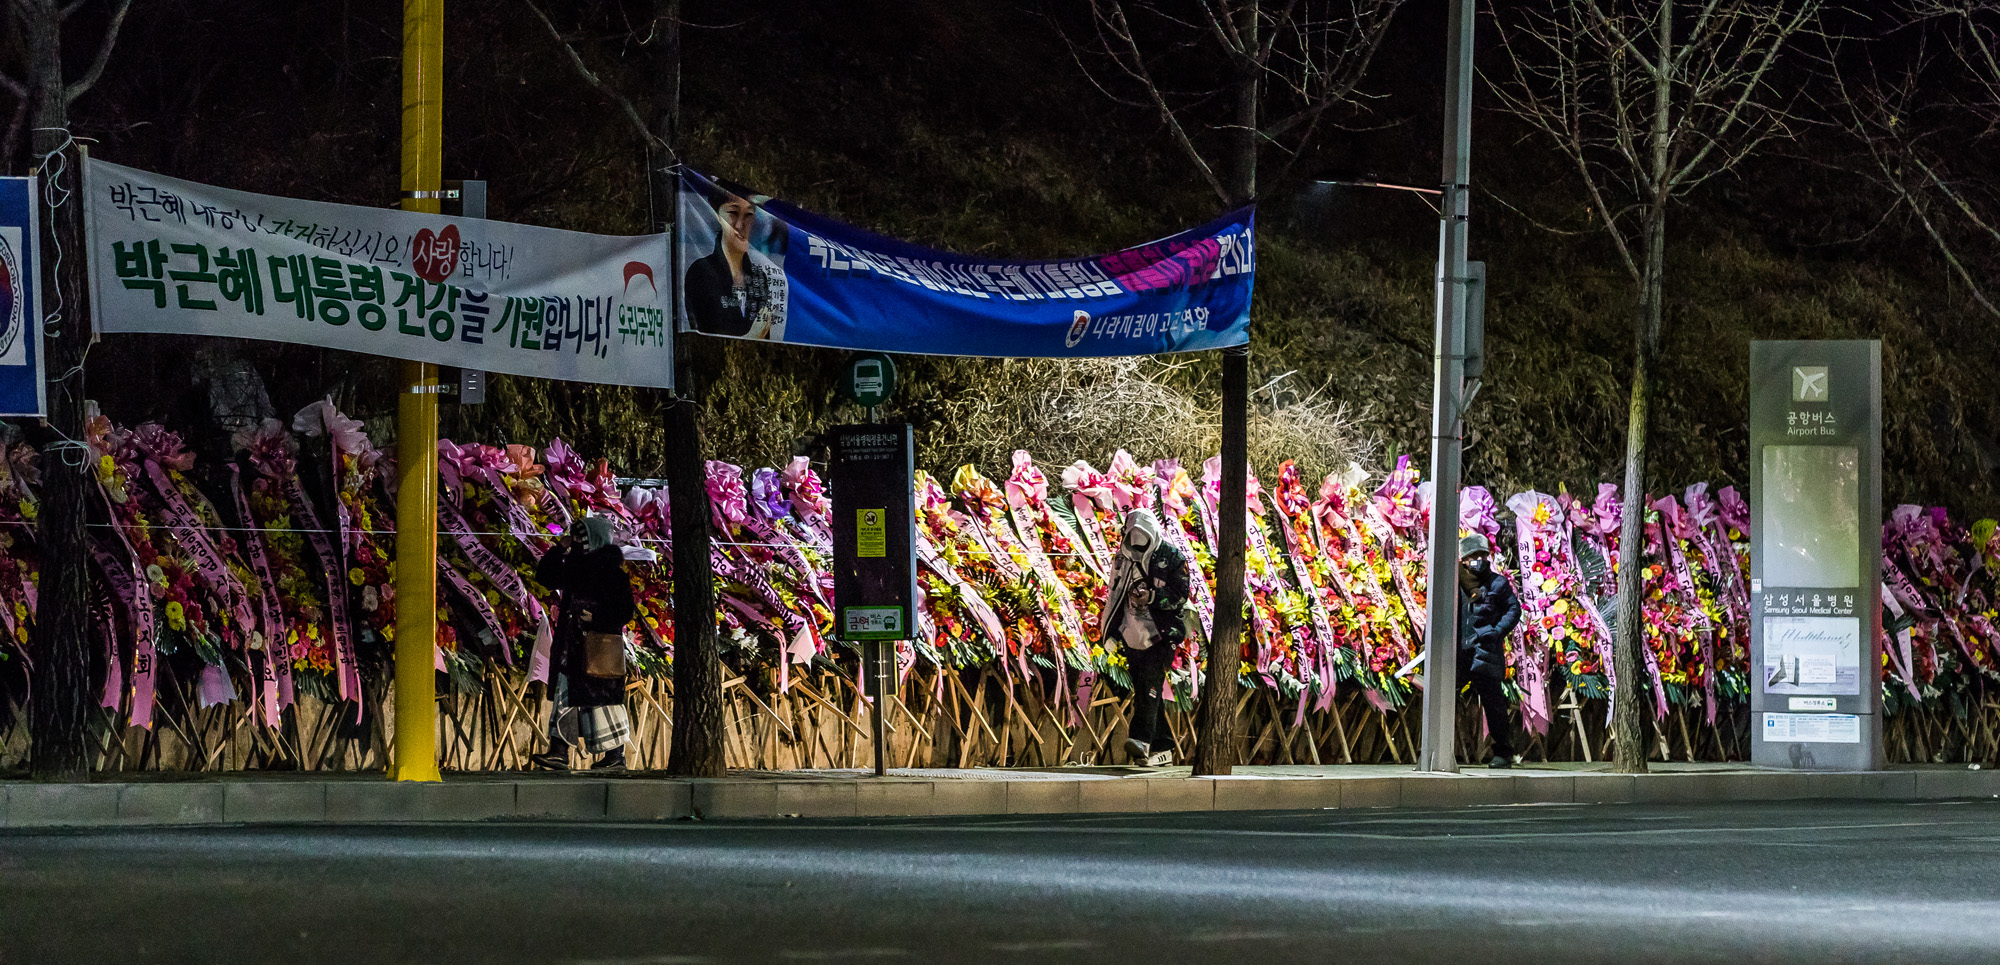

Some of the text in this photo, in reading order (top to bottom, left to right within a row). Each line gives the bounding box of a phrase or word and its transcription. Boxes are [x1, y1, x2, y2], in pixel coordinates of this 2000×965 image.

[110, 182, 187, 225] 박근혜
[412, 236, 515, 281] 사랑합니다!
[0, 241, 20, 325] ORPORATION
[111, 238, 614, 360] 박근혜 대통령 건강을 기원합니다!
[617, 303, 664, 348] 우리공화당
[1786, 411, 1836, 425] 공항버스
[1787, 427, 1836, 437] Airport Bus
[1763, 593, 1854, 608] 삼성서울병원
[1764, 606, 1853, 615] Samsung Seoul Medical Center
[849, 616, 870, 630] 금연
